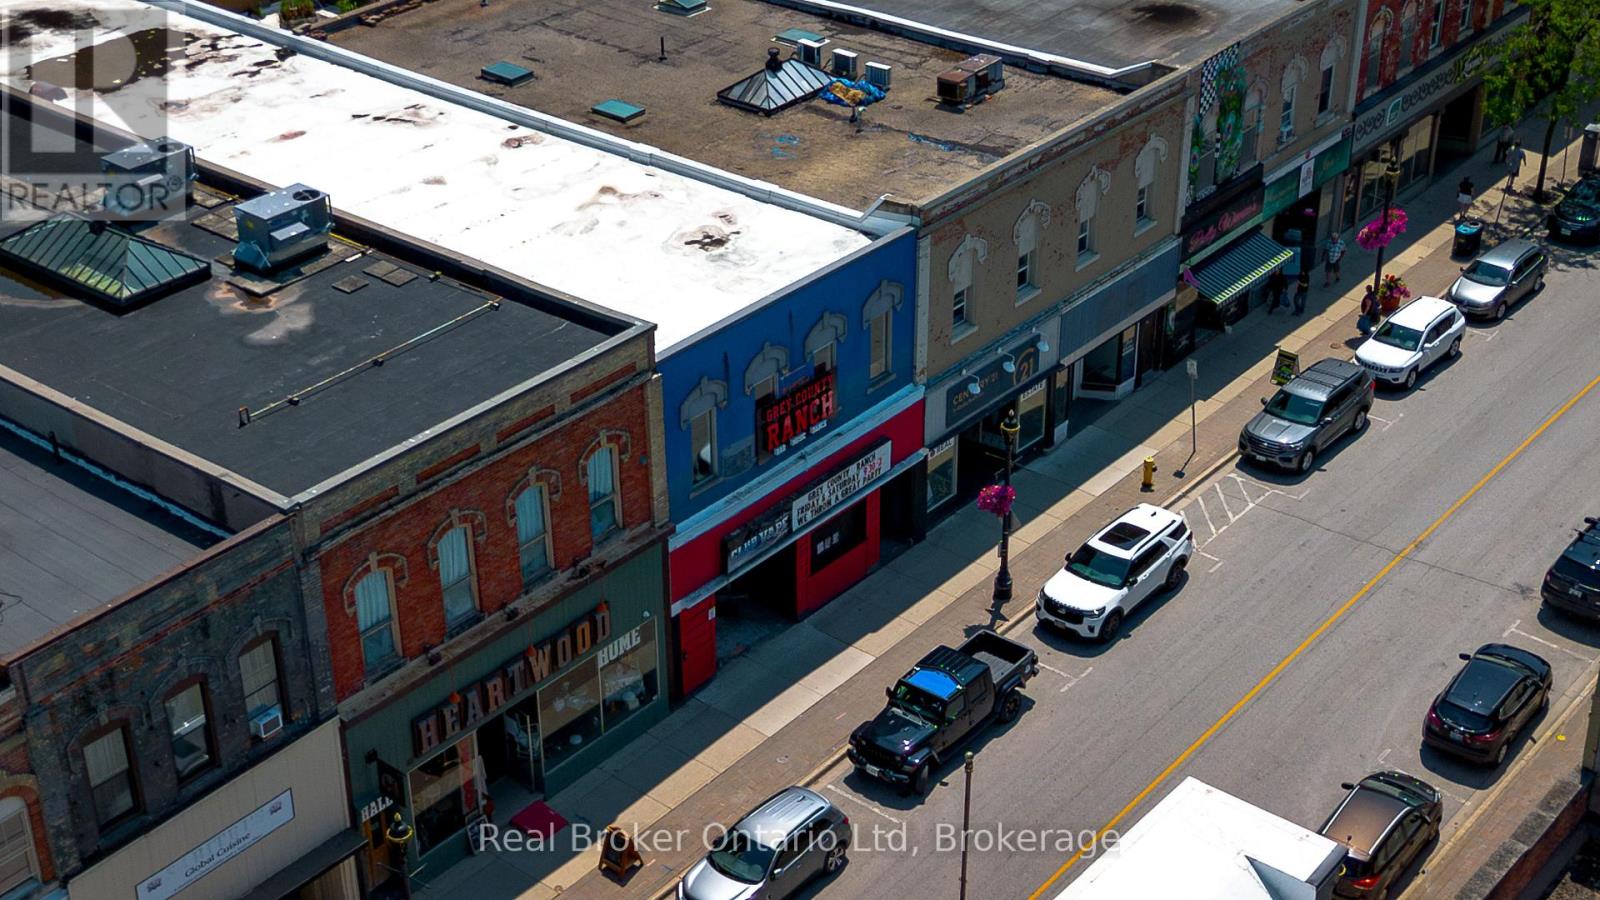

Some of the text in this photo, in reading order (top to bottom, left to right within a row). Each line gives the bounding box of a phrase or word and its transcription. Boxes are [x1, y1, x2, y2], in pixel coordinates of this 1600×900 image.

[766, 398, 792, 422] GREY
[795, 375, 833, 405] COUNTY
[766, 390, 834, 455] RANCH
[797, 500, 820, 517] FRIDAY
[828, 473, 859, 496] SATURDAY
[808, 452, 876, 501] GREY COUNTY RANCH
[862, 467, 882, 486] PARTY
[597, 626, 641, 668] HOME
[413, 609, 611, 756] HEARTWOOD
[361, 796, 394, 823] HALL
[184, 854, 215, 878] Global
[217, 832, 251, 857] Cuisine
